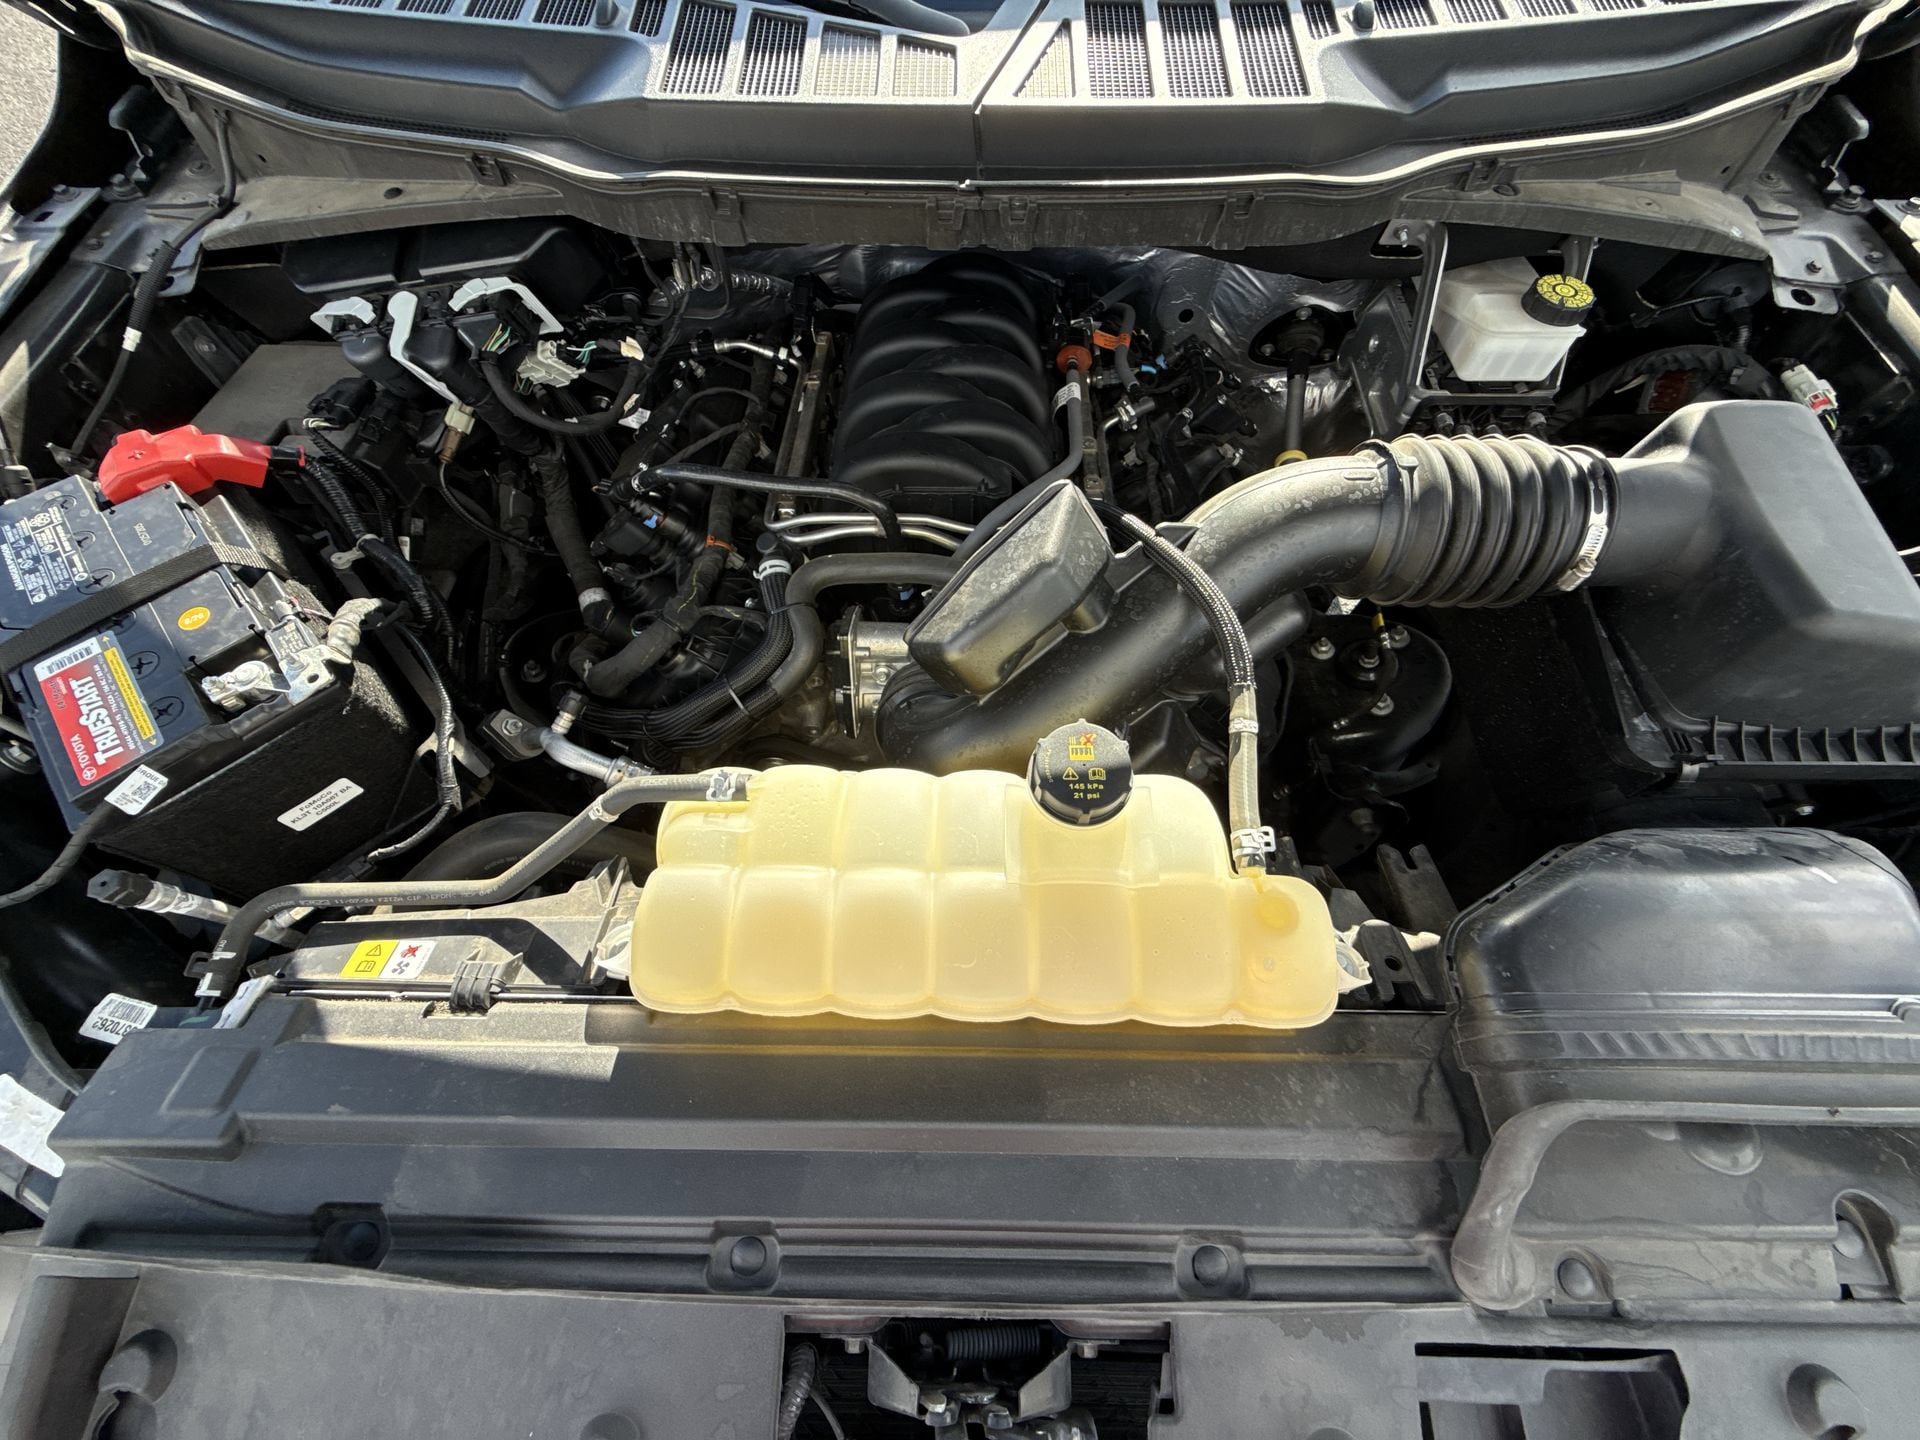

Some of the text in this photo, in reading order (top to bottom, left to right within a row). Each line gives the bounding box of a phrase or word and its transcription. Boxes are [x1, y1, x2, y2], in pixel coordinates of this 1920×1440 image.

[70, 734, 91, 768] TOYOTA
[1087, 792, 1100, 800] psi
[92, 1016, 138, 1036] 370262
